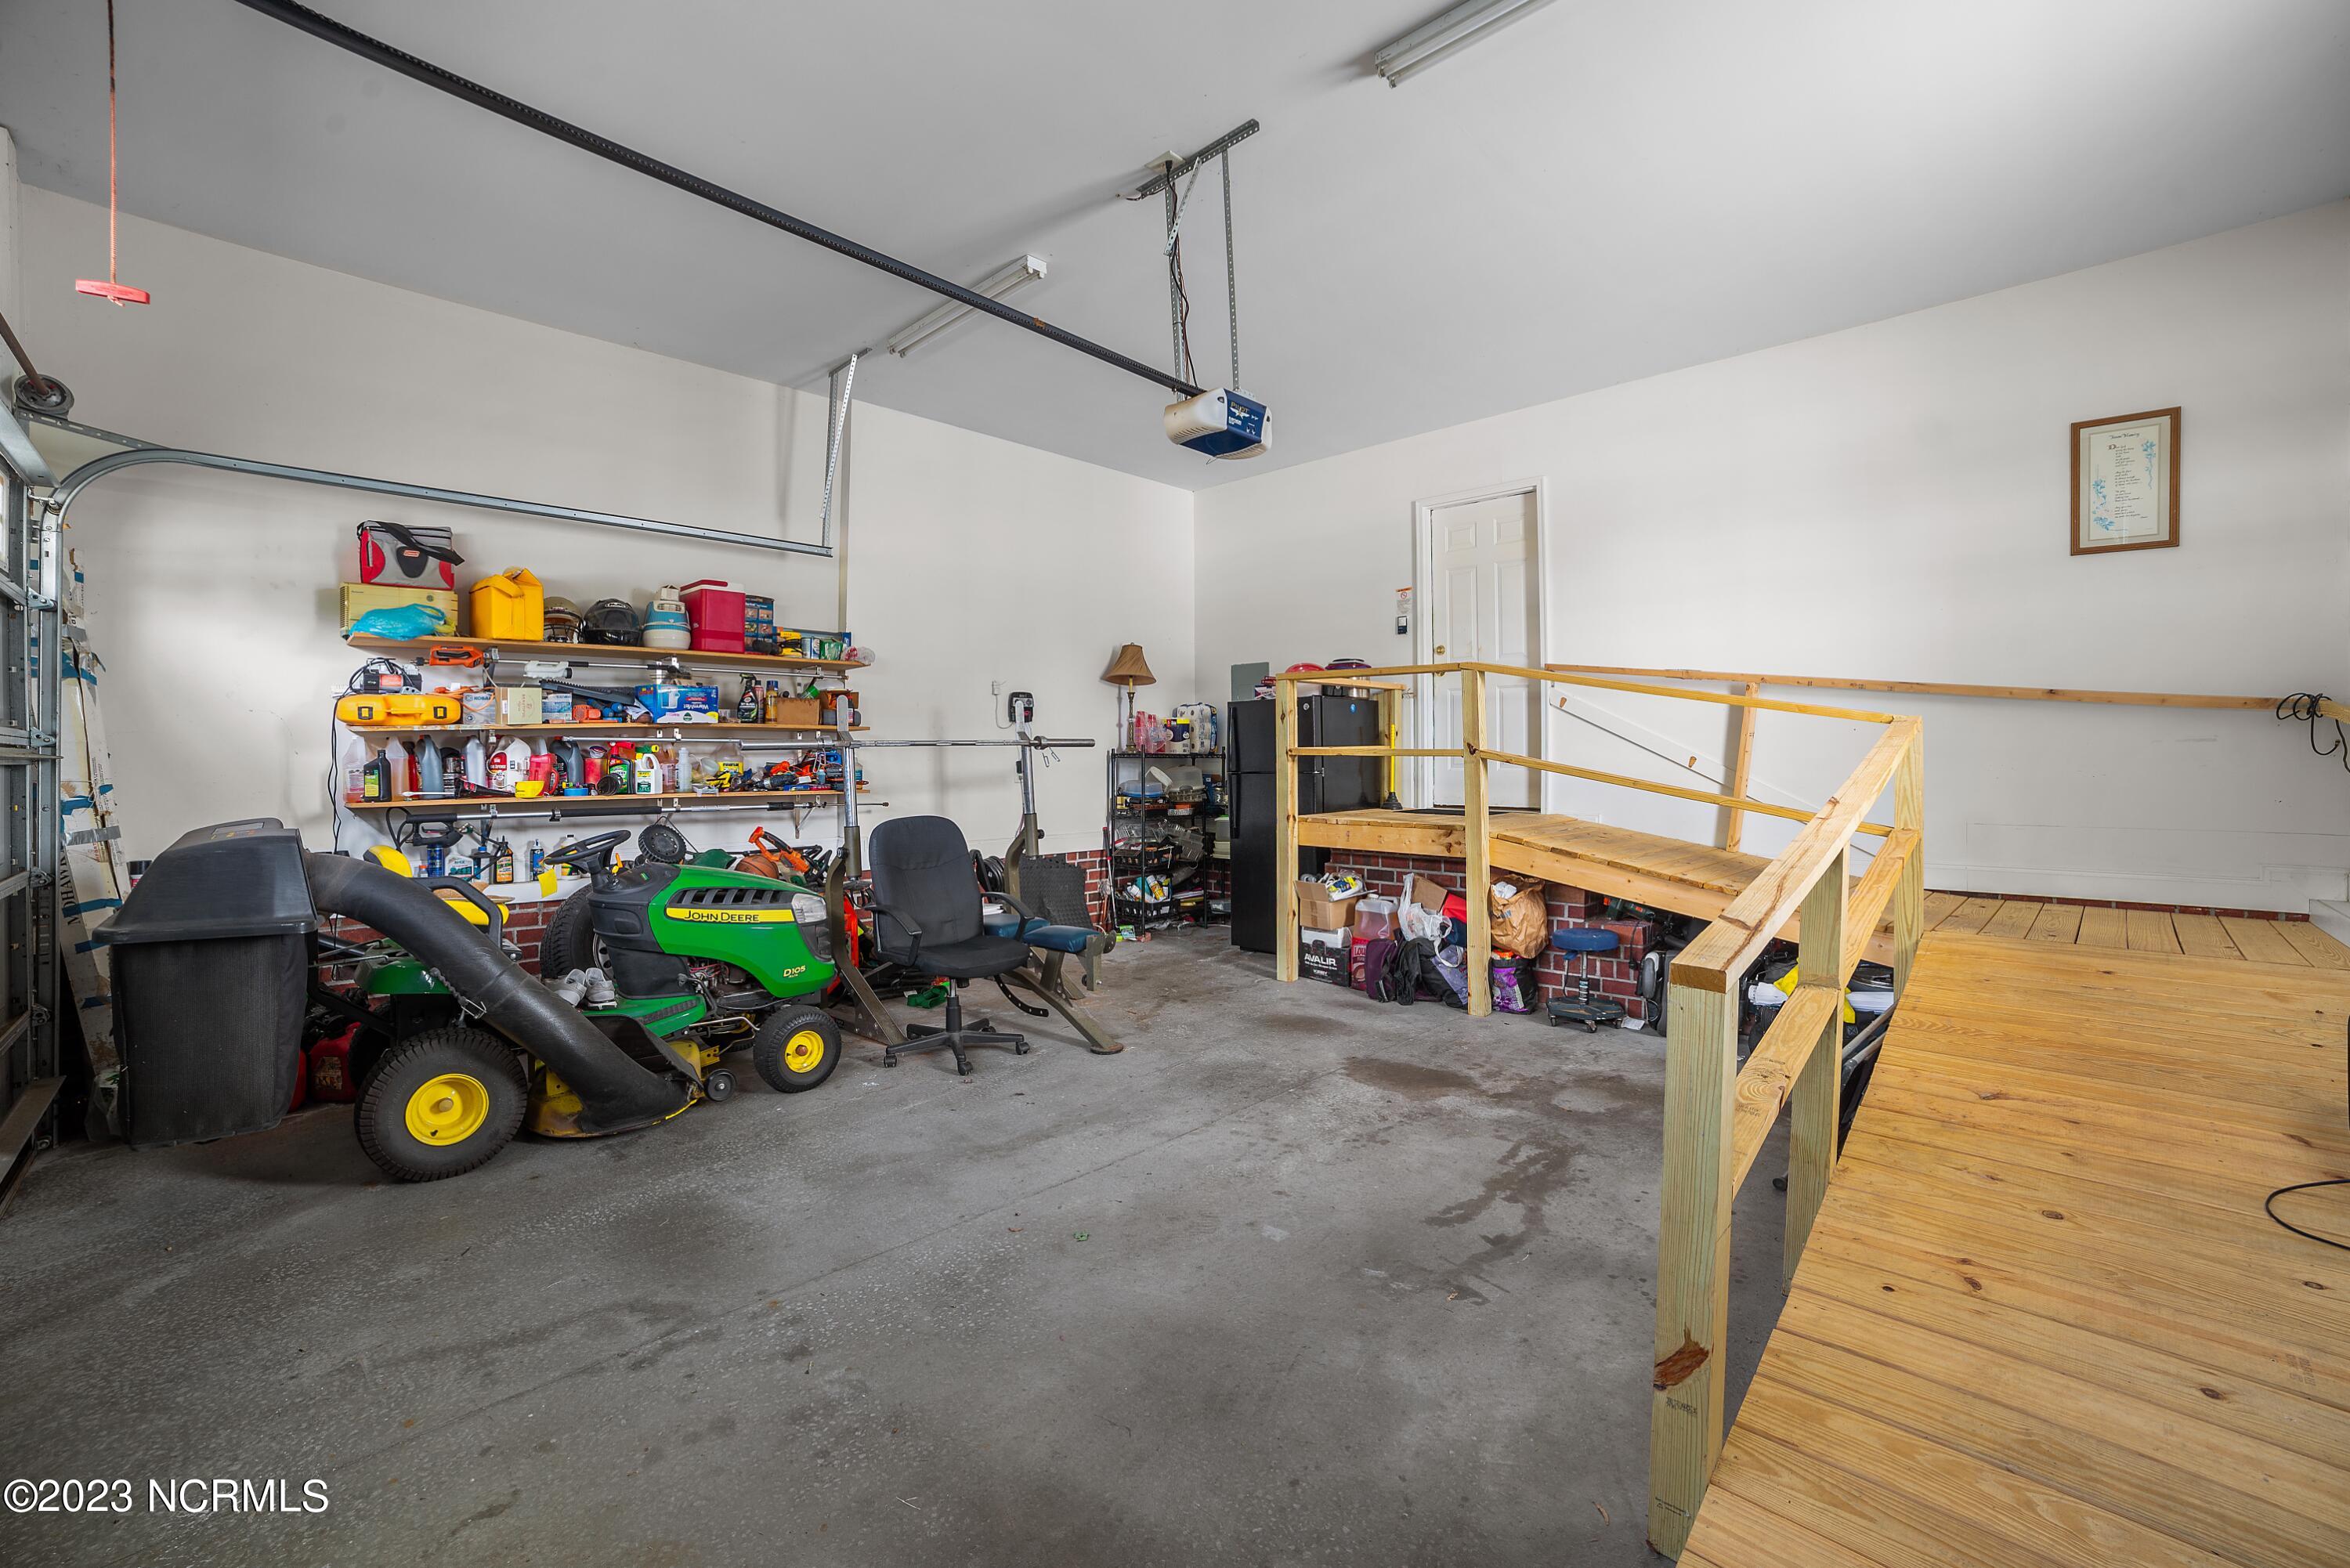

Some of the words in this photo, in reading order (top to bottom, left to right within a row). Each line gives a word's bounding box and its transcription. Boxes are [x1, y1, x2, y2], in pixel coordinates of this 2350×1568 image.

[1231, 402, 1249, 413] PILOT
[685, 910, 718, 921] JOHN
[721, 912, 759, 922] DEERE
[1354, 947, 1366, 956] LOU
[1304, 953, 1337, 966] AVALIR
[783, 965, 806, 977] D105
